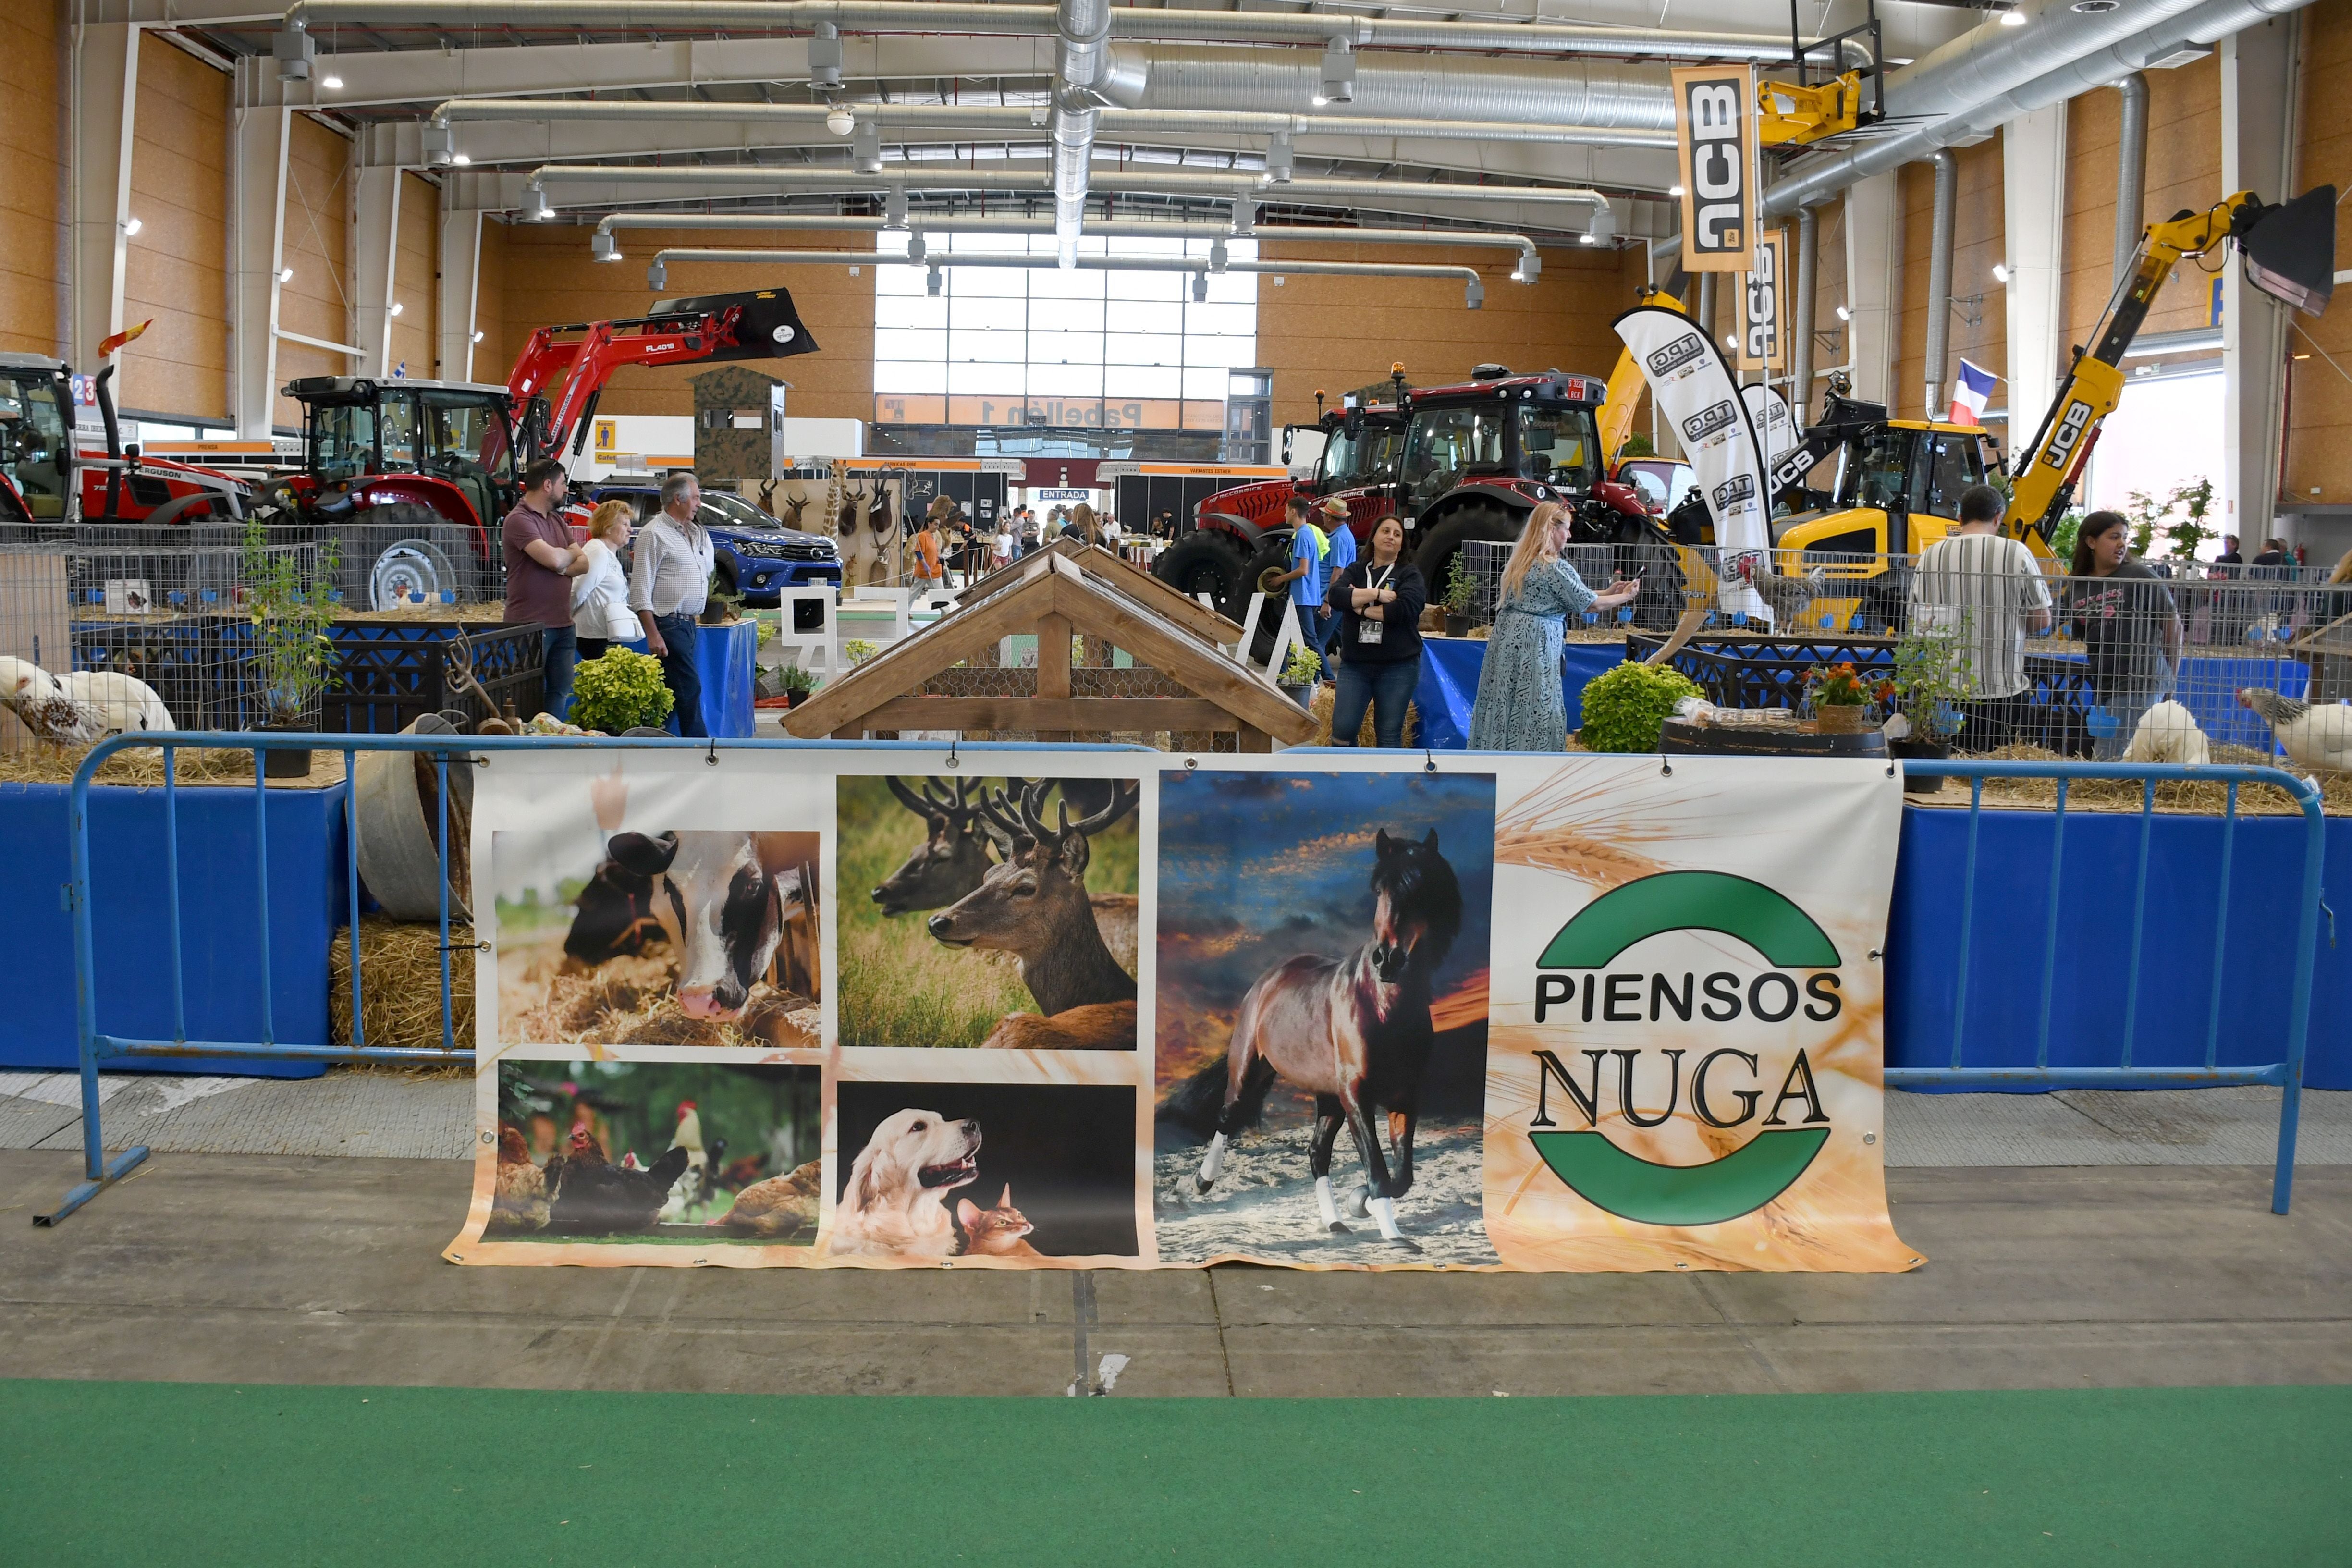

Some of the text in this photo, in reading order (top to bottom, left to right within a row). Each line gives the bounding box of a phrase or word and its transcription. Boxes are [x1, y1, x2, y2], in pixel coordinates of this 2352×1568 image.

[2049, 402, 2090, 467] JCB
[139, 468, 181, 478] ERGUSON
[1323, 491, 1364, 503] McCORMIC
[1534, 972, 1841, 1023] PIENSOS
[1530, 1048, 1830, 1127] NUGA
